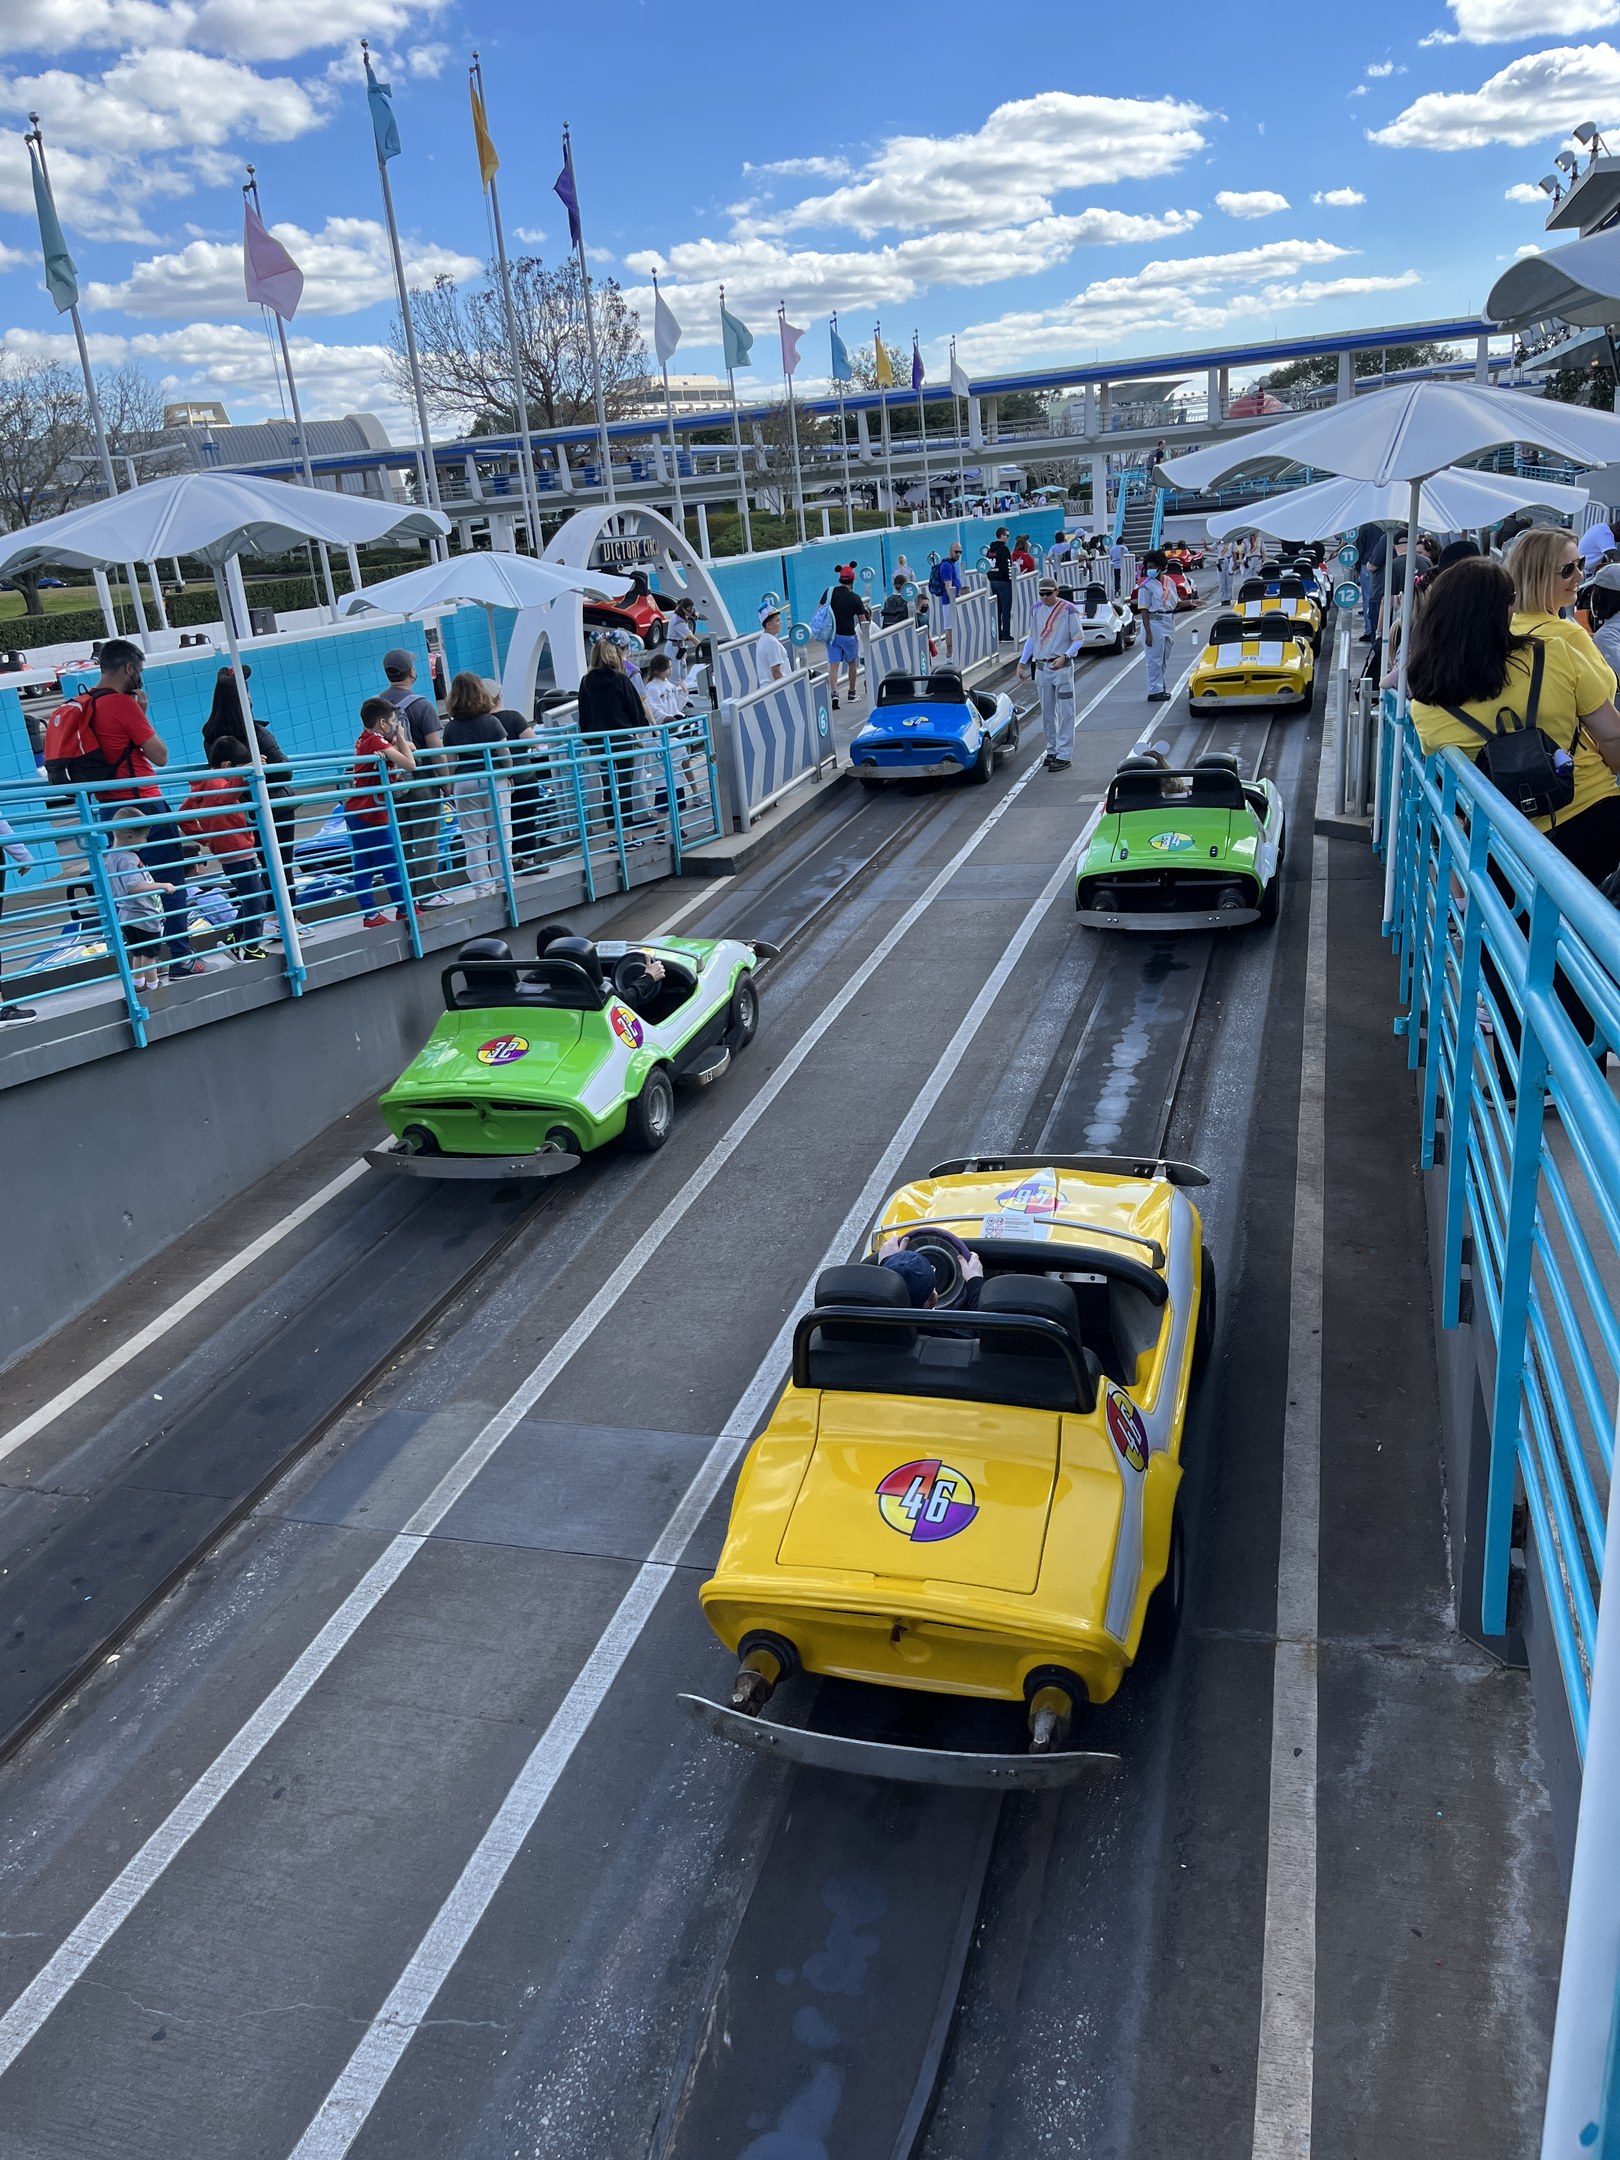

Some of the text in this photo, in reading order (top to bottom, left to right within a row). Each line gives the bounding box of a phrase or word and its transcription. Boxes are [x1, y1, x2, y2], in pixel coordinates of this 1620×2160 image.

[1344, 530, 1356, 539] 10
[603, 540, 640, 561] VICTORY
[1342, 551, 1355, 562] 11
[862, 571, 873, 579] 10
[906, 587, 914, 597] 5
[1338, 589, 1356, 603] 12
[795, 629, 805, 640] 6
[820, 713, 826, 730] 6
[1161, 835, 1181, 847] 34
[616, 1012, 638, 1043] 32
[486, 1041, 521, 1059] 32
[1012, 1188, 1051, 1206] 46
[899, 1475, 959, 1524] 46
